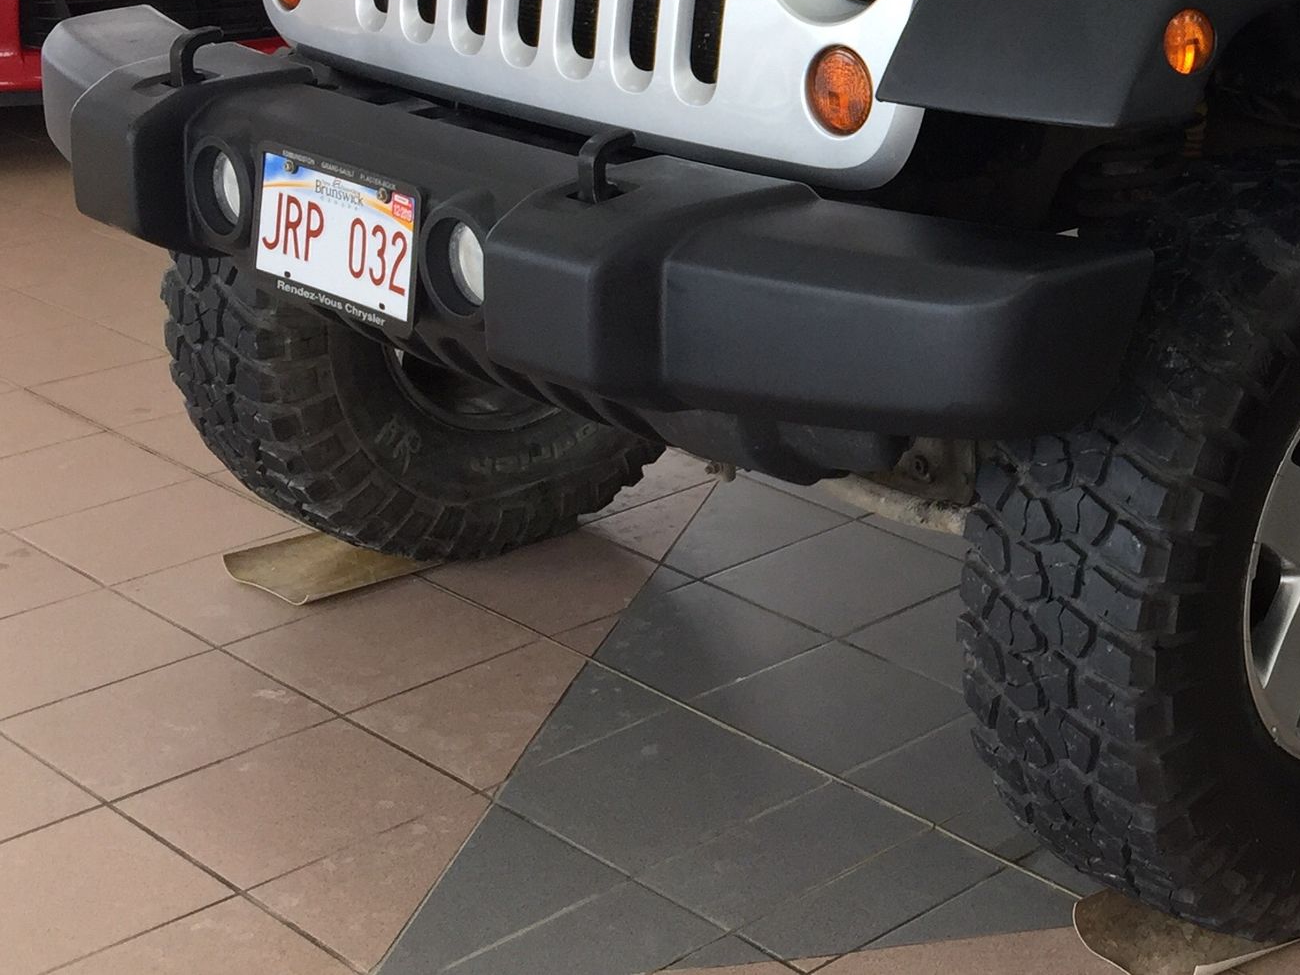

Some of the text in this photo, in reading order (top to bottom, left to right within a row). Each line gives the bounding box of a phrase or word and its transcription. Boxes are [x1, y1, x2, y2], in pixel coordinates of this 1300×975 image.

[315, 179, 364, 206] Brunswick
[262, 192, 408, 296] JRP 032
[277, 279, 386, 326] Rendez-Vous Chrysler
